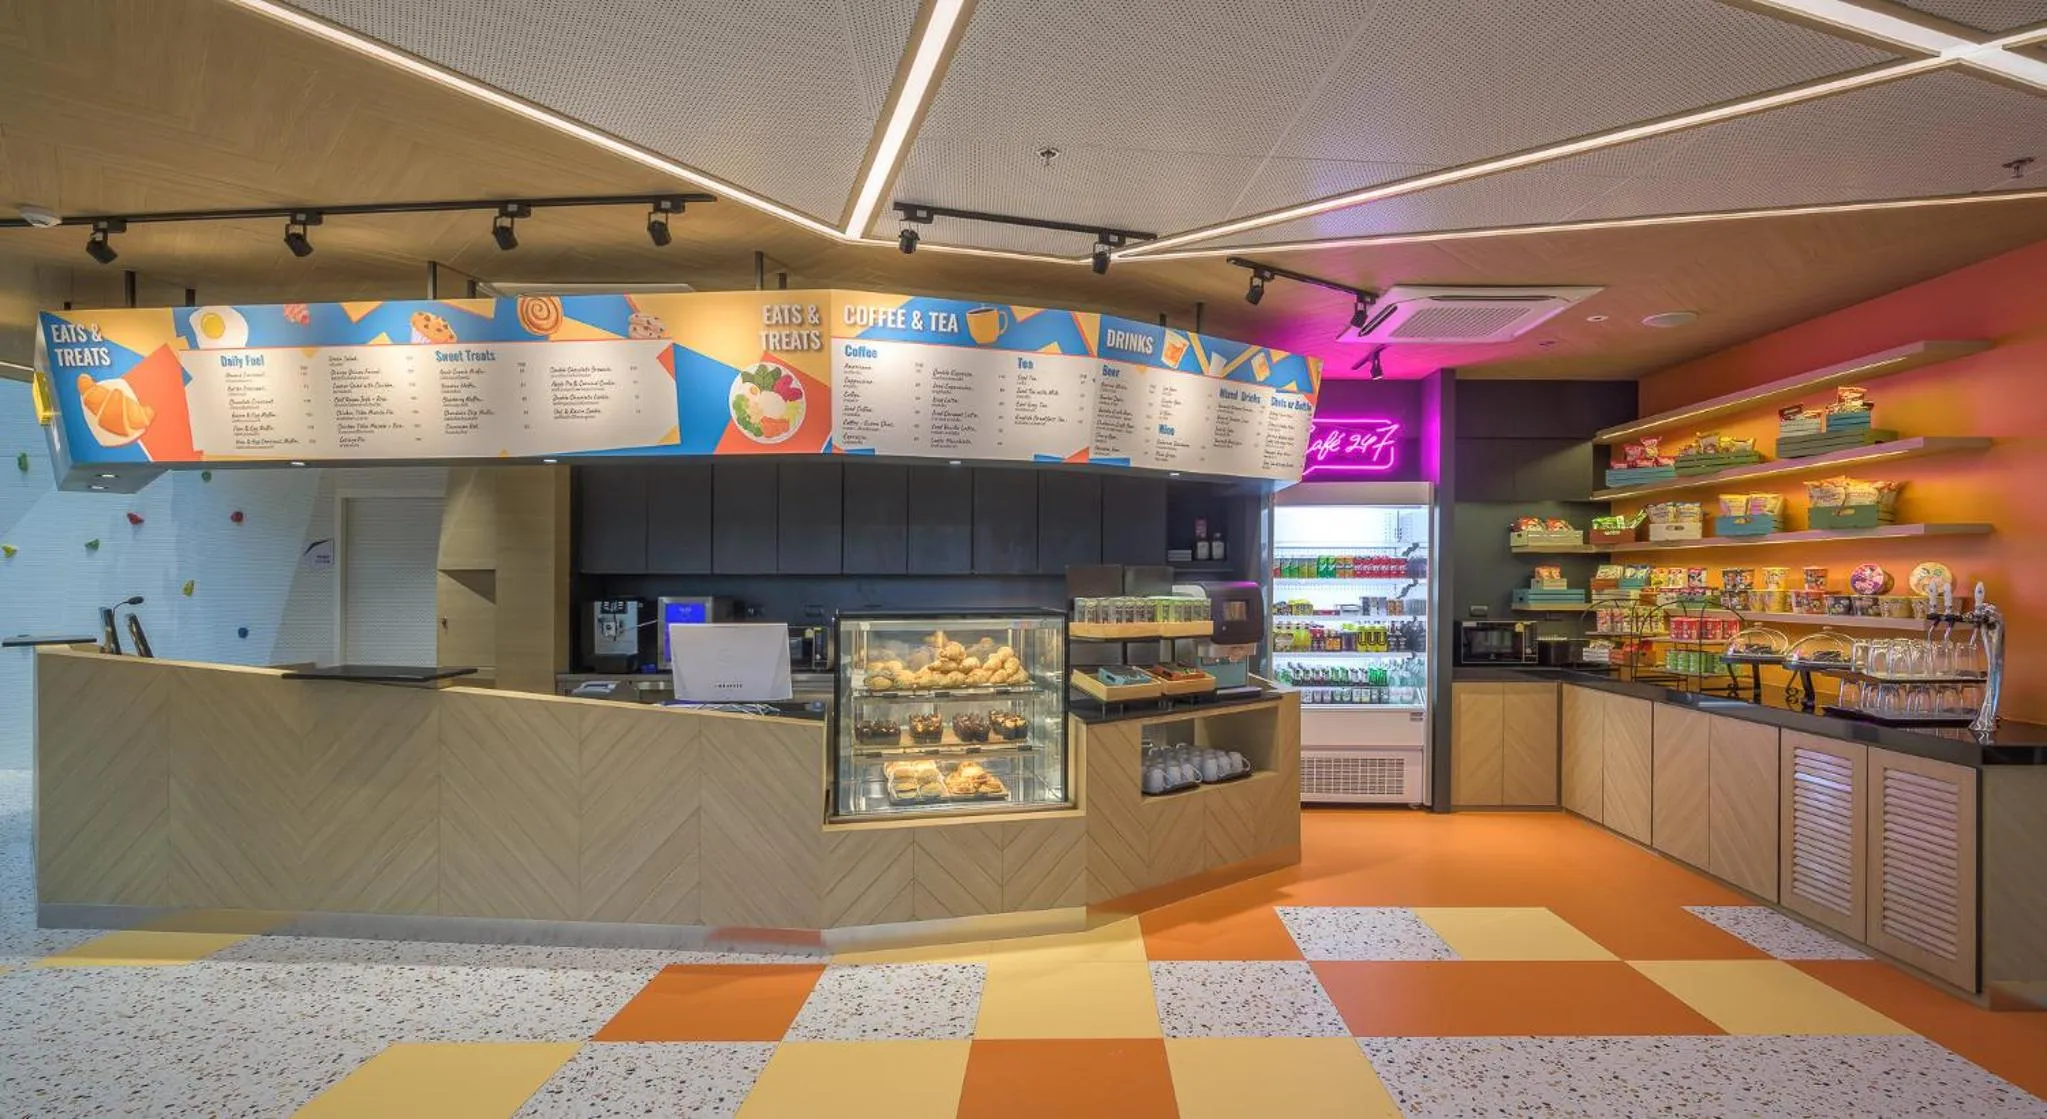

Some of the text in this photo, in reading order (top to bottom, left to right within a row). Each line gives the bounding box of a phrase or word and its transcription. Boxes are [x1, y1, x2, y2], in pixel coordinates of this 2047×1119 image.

[762, 304, 820, 326] EATS &
[843, 305, 959, 333] COFFEE & TEA
[51, 322, 103, 343] EATS &
[760, 330, 822, 351] TREATS
[1106, 328, 1153, 355] DRINKS
[54, 346, 112, 367] TREATS
[435, 349, 496, 362] Sweet Treats
[844, 344, 879, 359] Coffee
[220, 353, 264, 368] Daily Fuel
[1018, 357, 1034, 369] Tea
[1101, 363, 1120, 378] Beer
[1219, 387, 1261, 404] Mixed Drinks
[1158, 423, 1176, 436] Wine
